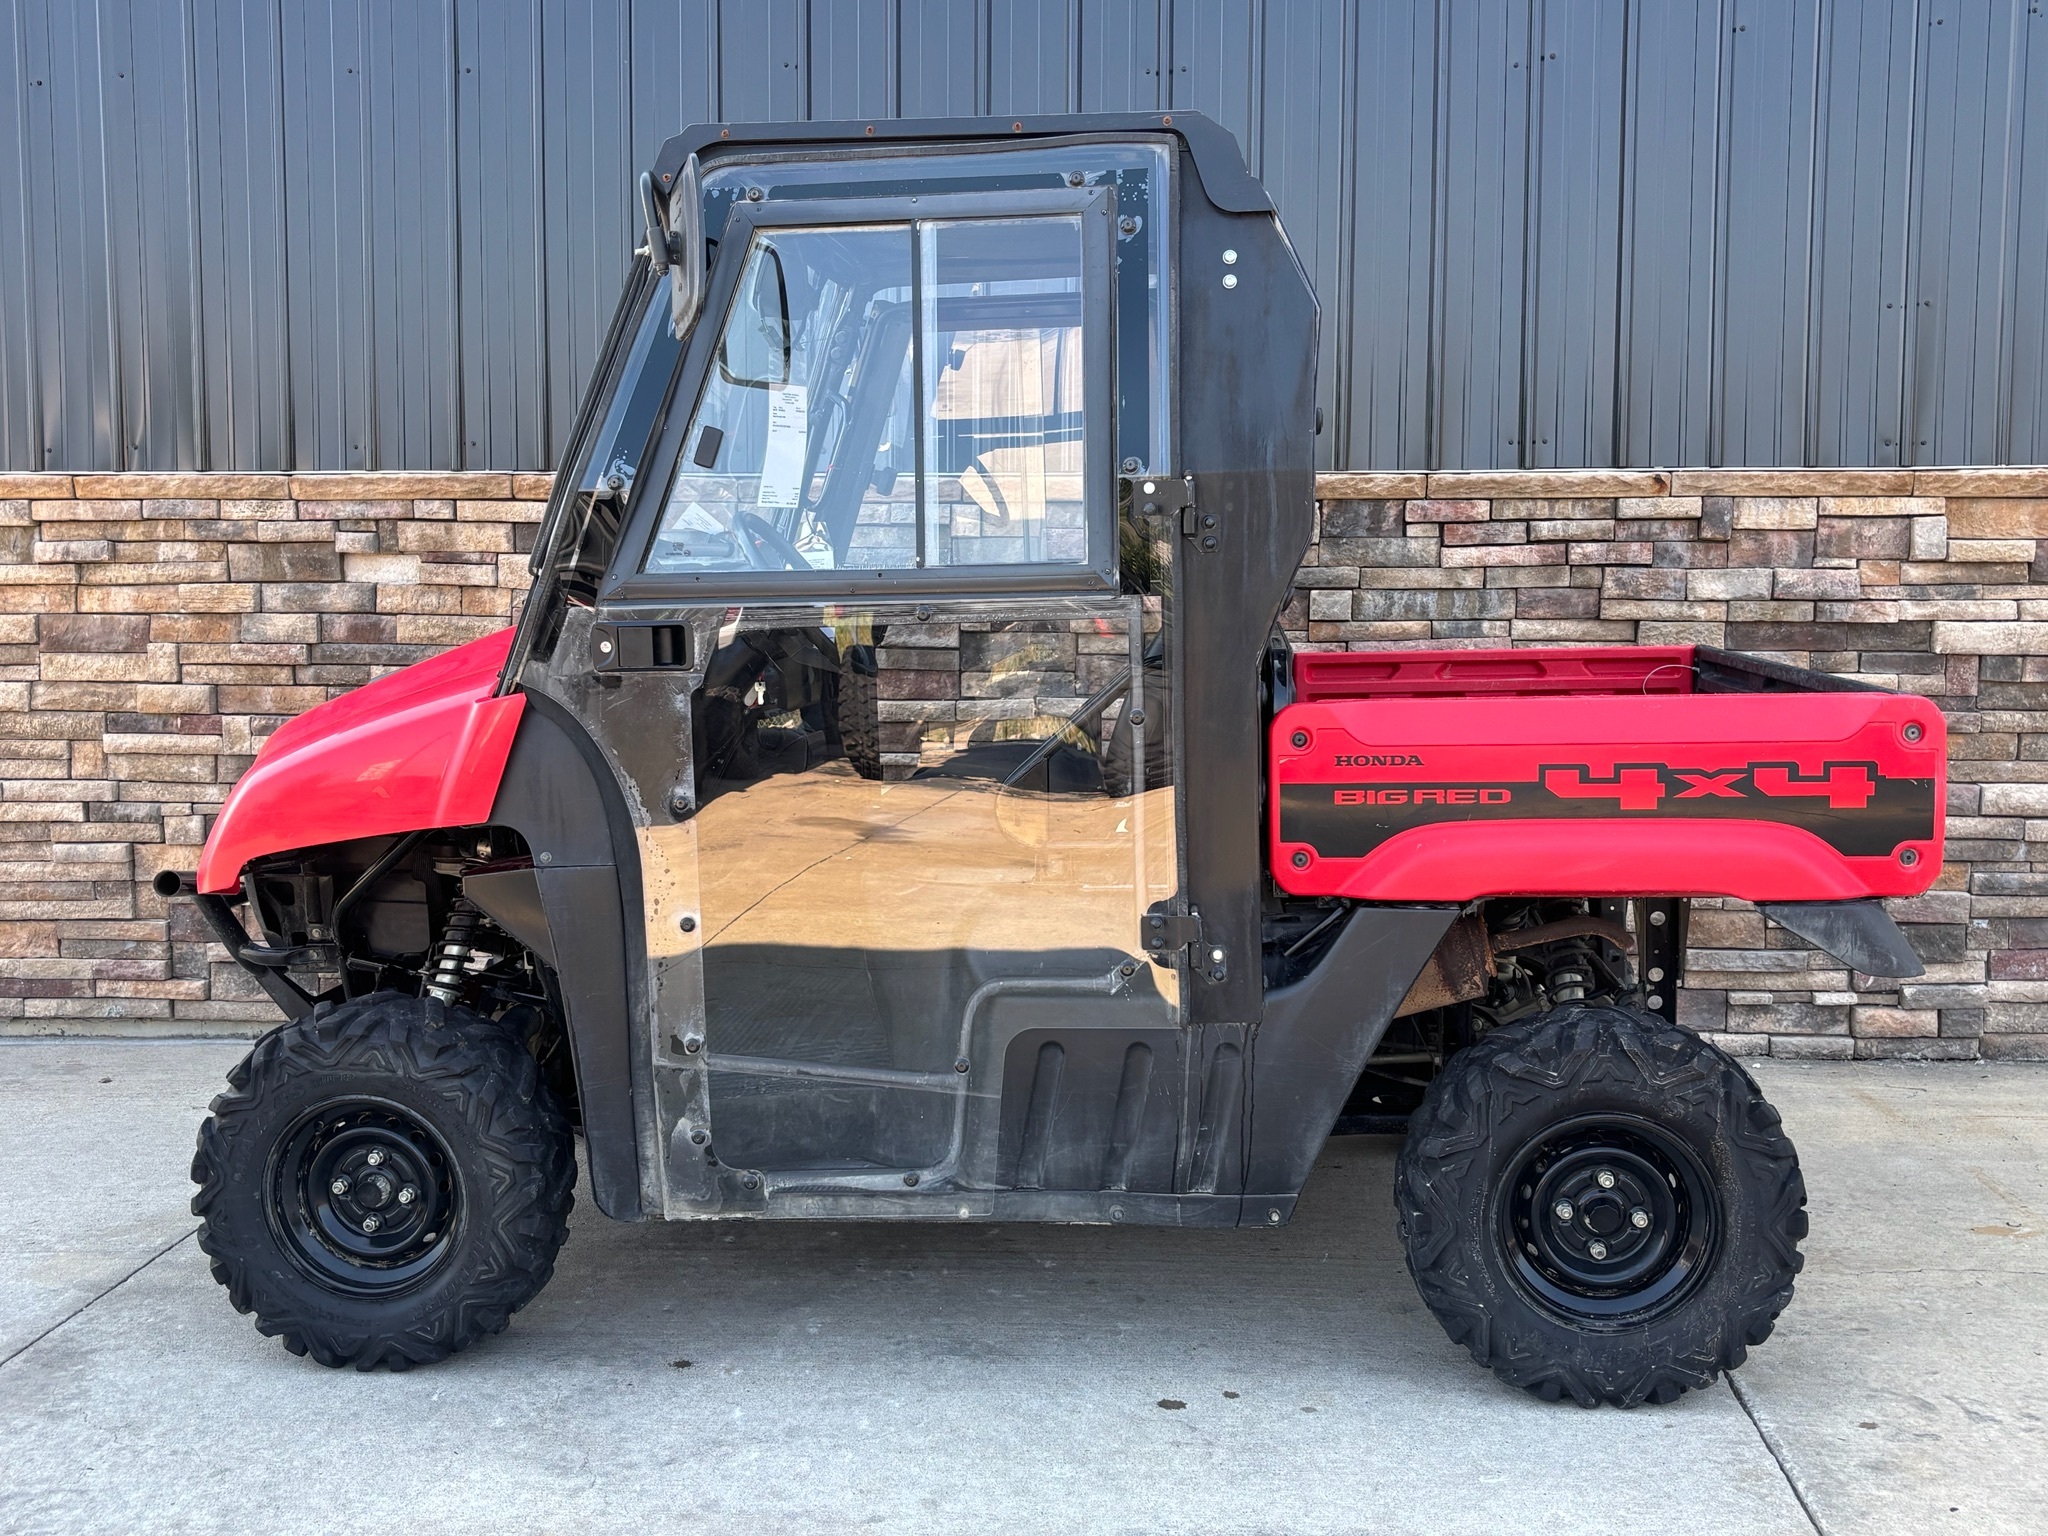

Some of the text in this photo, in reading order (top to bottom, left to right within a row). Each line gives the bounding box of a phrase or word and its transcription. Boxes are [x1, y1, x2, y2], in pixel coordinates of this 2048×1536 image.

[1334, 755, 1425, 767] HONDA
[1334, 789, 1511, 805] BIG RED
